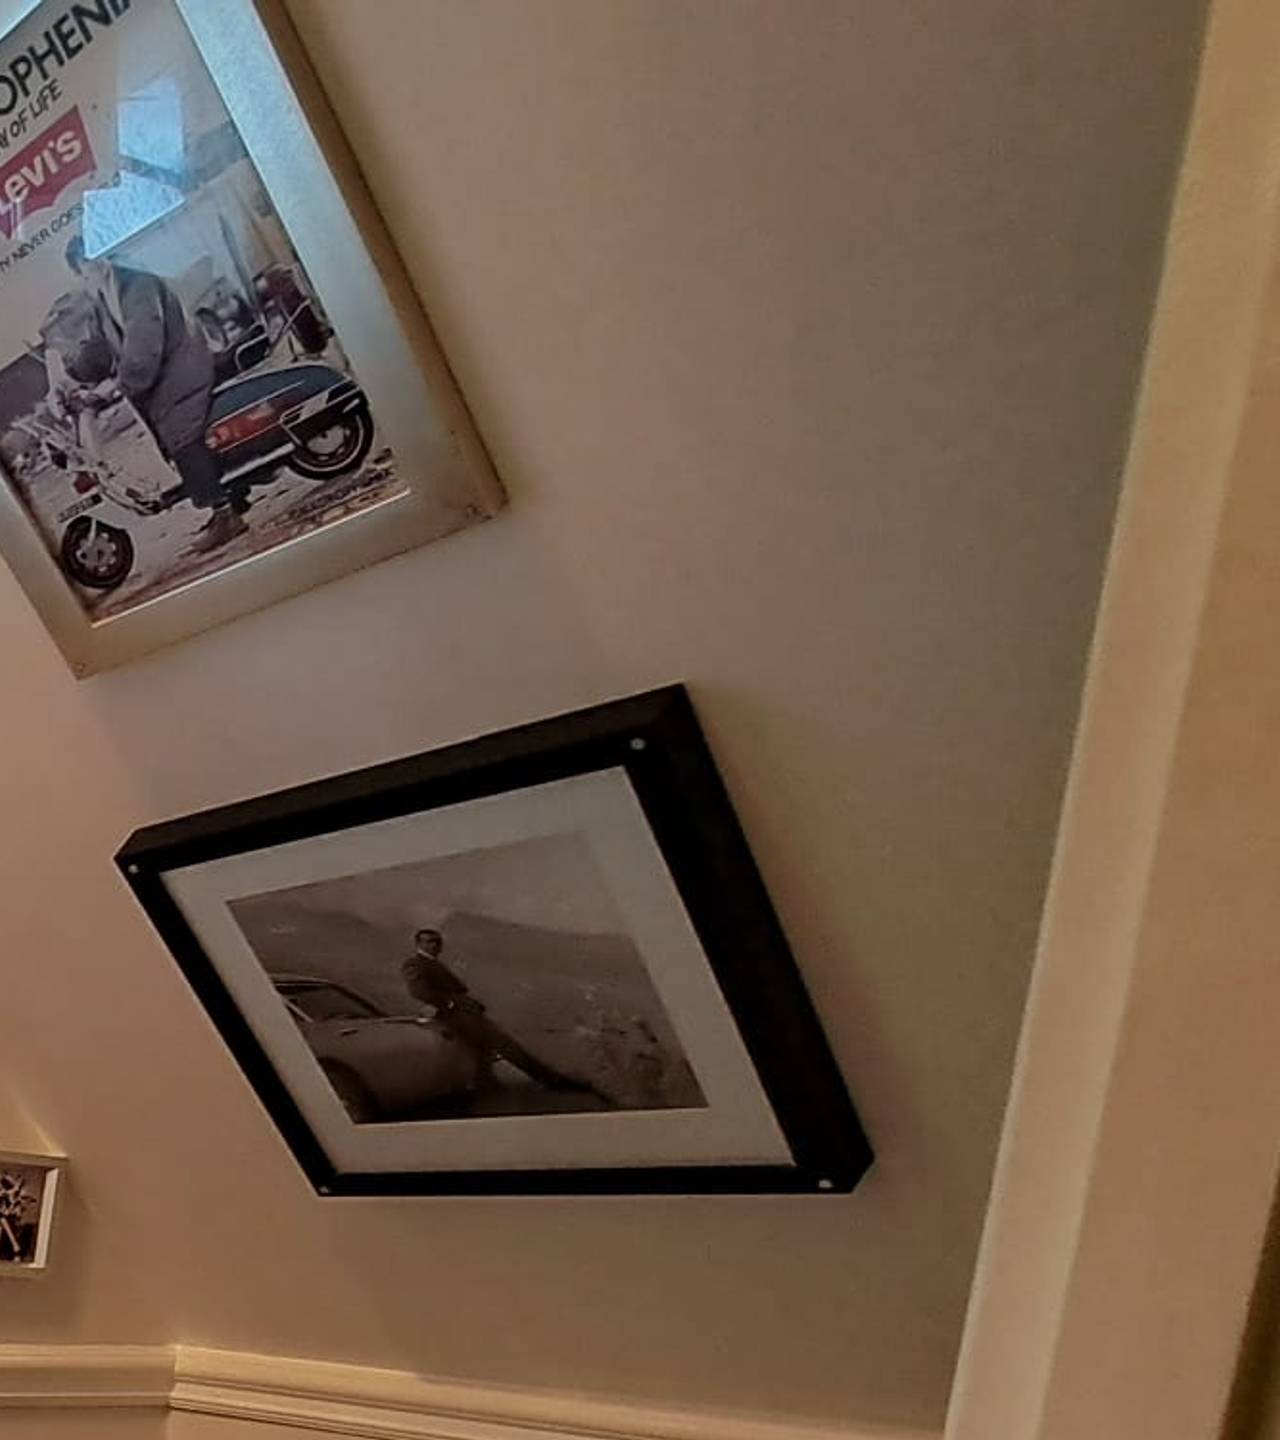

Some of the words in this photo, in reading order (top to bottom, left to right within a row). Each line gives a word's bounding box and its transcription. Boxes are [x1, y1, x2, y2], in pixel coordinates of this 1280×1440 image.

[10, 112, 29, 139] OF
[31, 79, 63, 120] LIFE
[11, 227, 52, 264] NEVER
